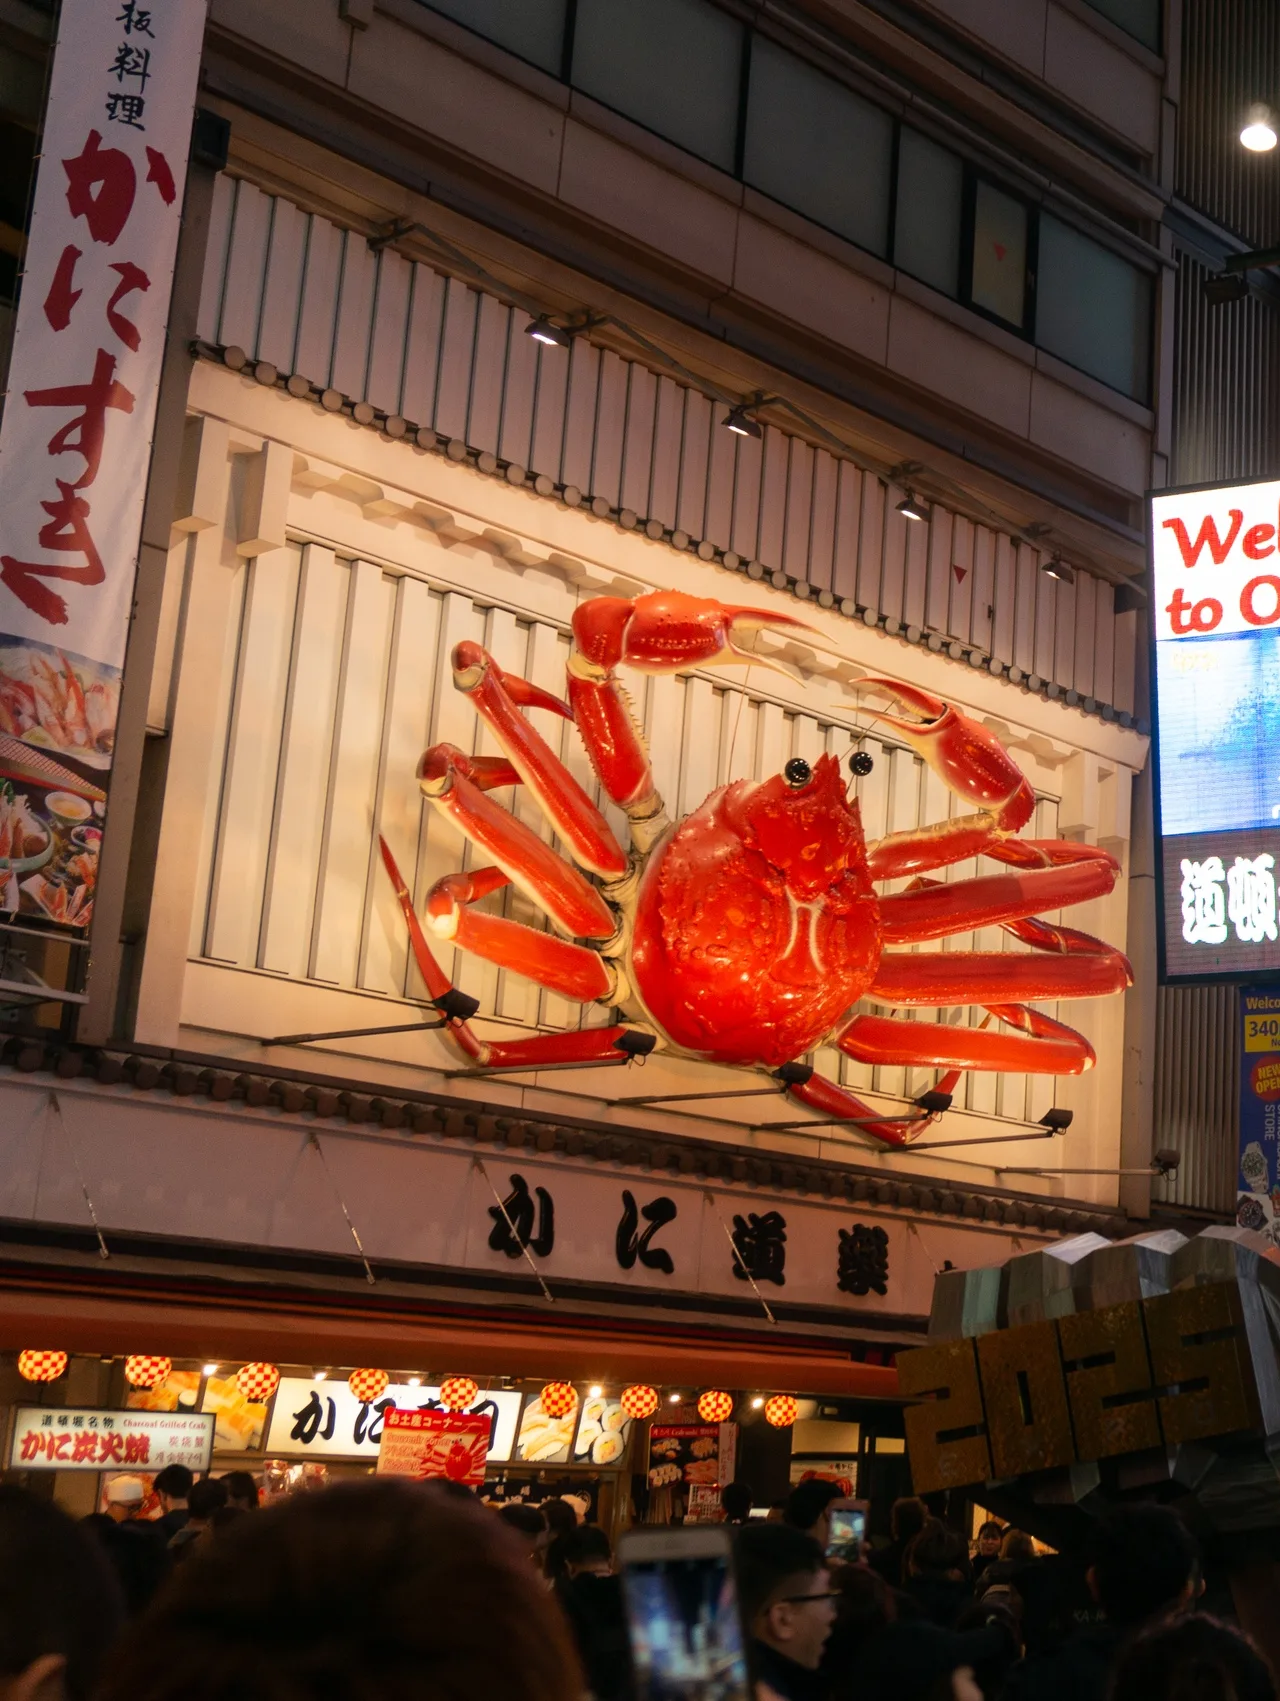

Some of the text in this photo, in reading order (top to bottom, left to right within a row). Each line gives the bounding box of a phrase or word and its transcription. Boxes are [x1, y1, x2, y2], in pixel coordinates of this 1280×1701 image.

[0, 127, 178, 627] かにすき
[1165, 587, 1223, 634] to
[1264, 1104, 1275, 1141] STORE
[487, 1172, 890, 1297] かに道楽
[41, 1414, 115, 1429] 道頓堀名物
[123, 1418, 207, 1430] Charcoal Grilled Crab
[388, 1412, 463, 1429] お土産コーナー
[20, 1429, 151, 1465] かに炭火焼
